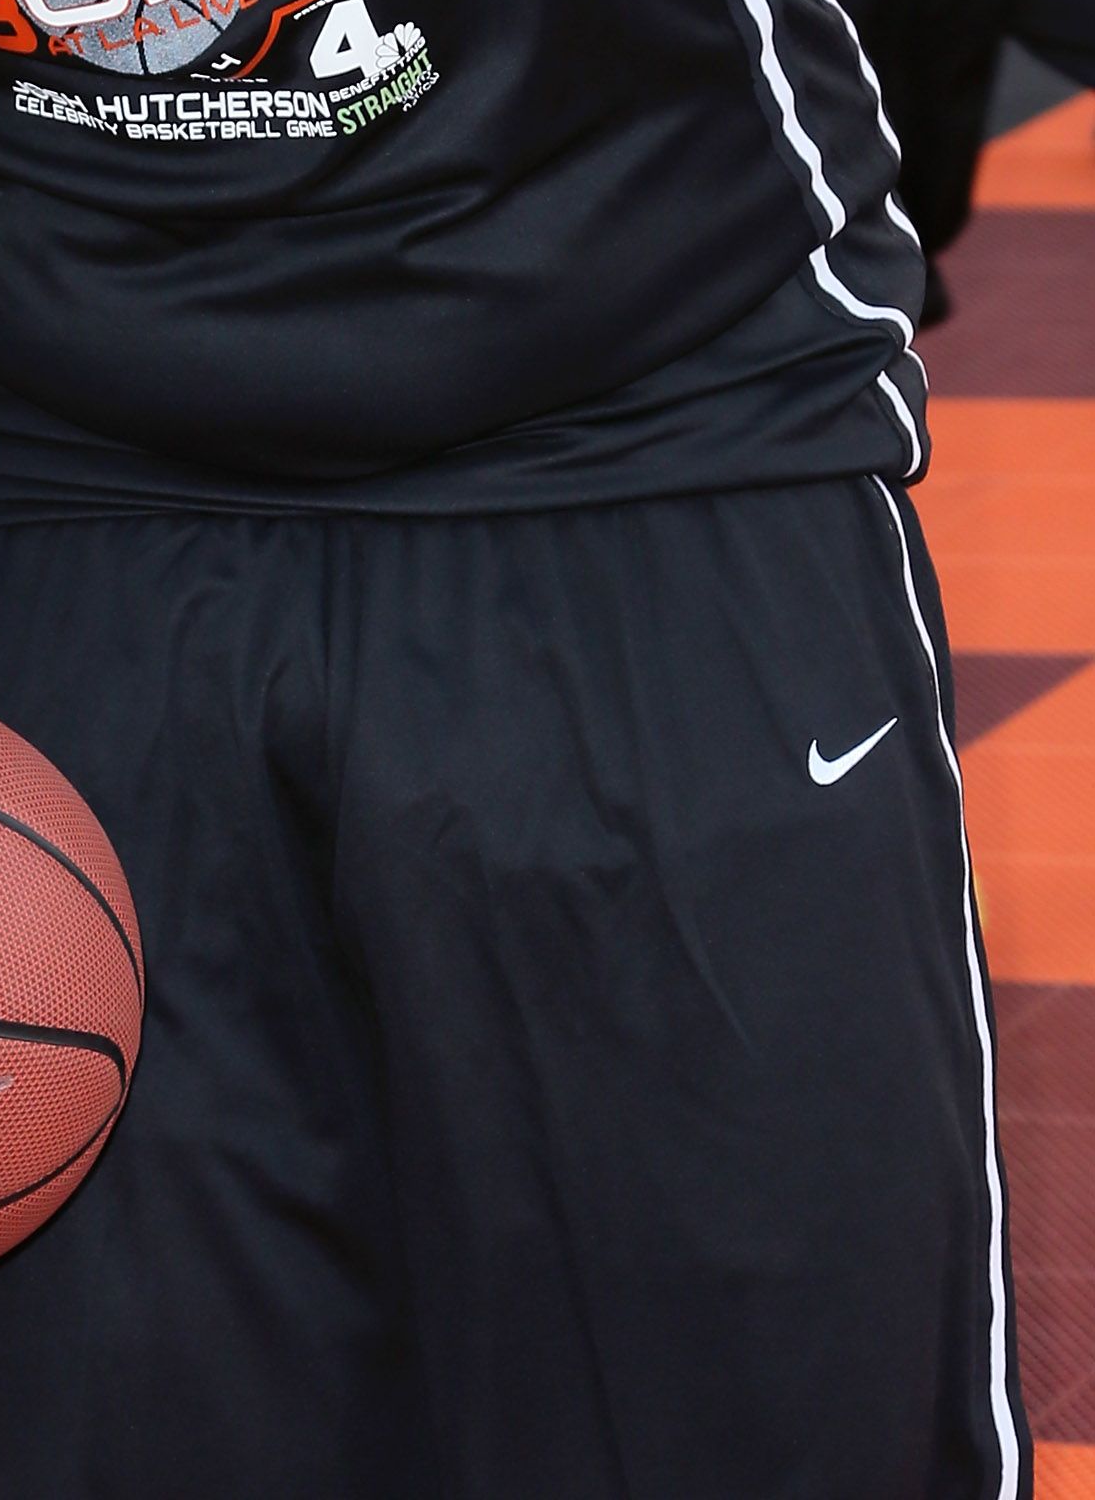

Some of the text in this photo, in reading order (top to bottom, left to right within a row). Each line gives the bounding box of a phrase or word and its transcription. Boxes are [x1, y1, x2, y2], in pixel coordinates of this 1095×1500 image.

[47, 31, 86, 56] AT
[328, 36, 426, 104] BENEFITTING
[336, 47, 431, 135] STRAIGHT
[14, 93, 338, 141] CELEBRITY BASKETBALL GAME
[95, 90, 331, 123] HUTCHERSON
